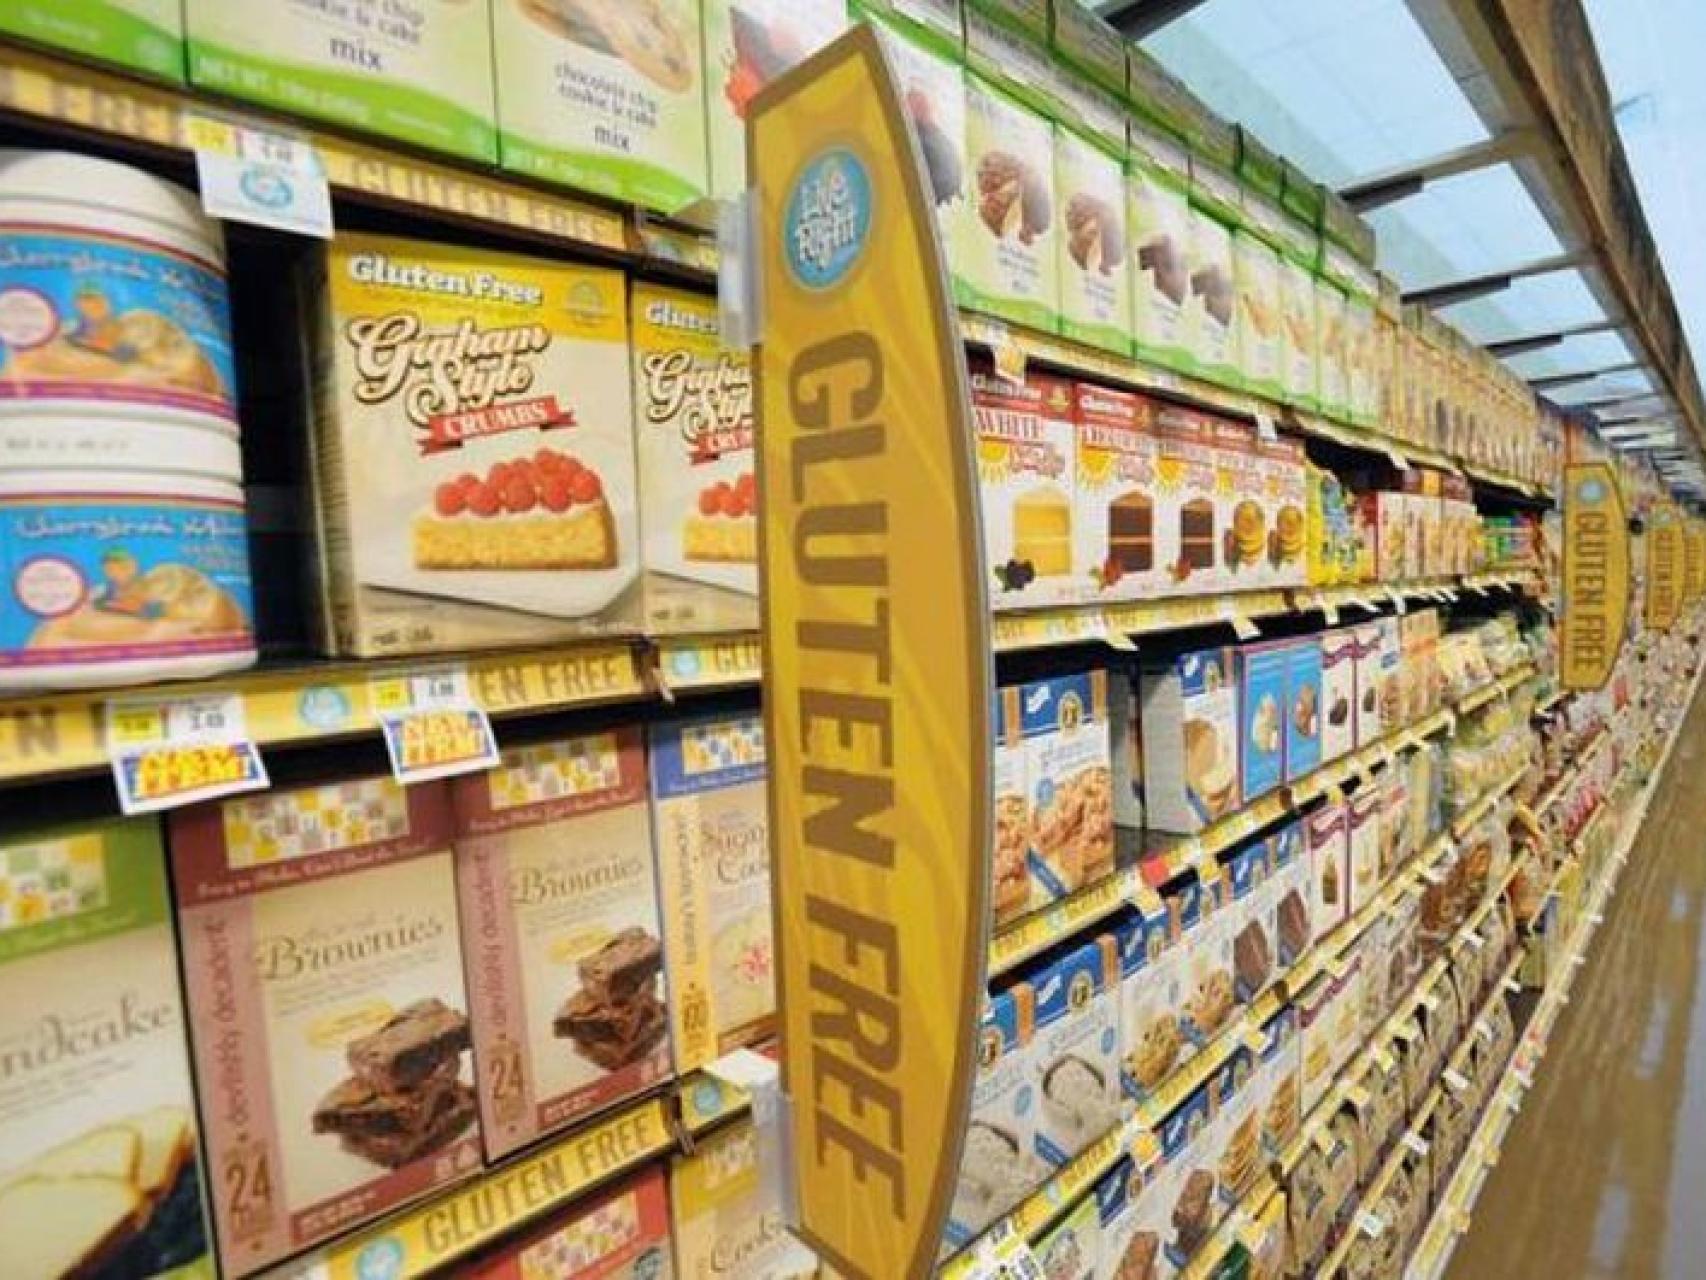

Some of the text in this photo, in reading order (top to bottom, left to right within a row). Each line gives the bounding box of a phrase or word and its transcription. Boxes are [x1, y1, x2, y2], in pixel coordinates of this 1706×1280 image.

[329, 38, 382, 71] mix
[594, 125, 631, 152] mix
[348, 252, 543, 307] Gluten Free
[347, 312, 553, 406] Graham
[405, 354, 537, 430] Style
[443, 401, 546, 442] CRUMBS
[1573, 511, 1608, 672] GLUTEN FREE
[544, 654, 618, 699] FREE
[787, 330, 906, 1223] GLUTEN FREE
[509, 853, 643, 905] Brownies
[260, 915, 443, 981] Brownies
[226, 1148, 272, 1204] 24
[423, 1158, 568, 1254] GLUTEN
[577, 1111, 654, 1179] FREE
